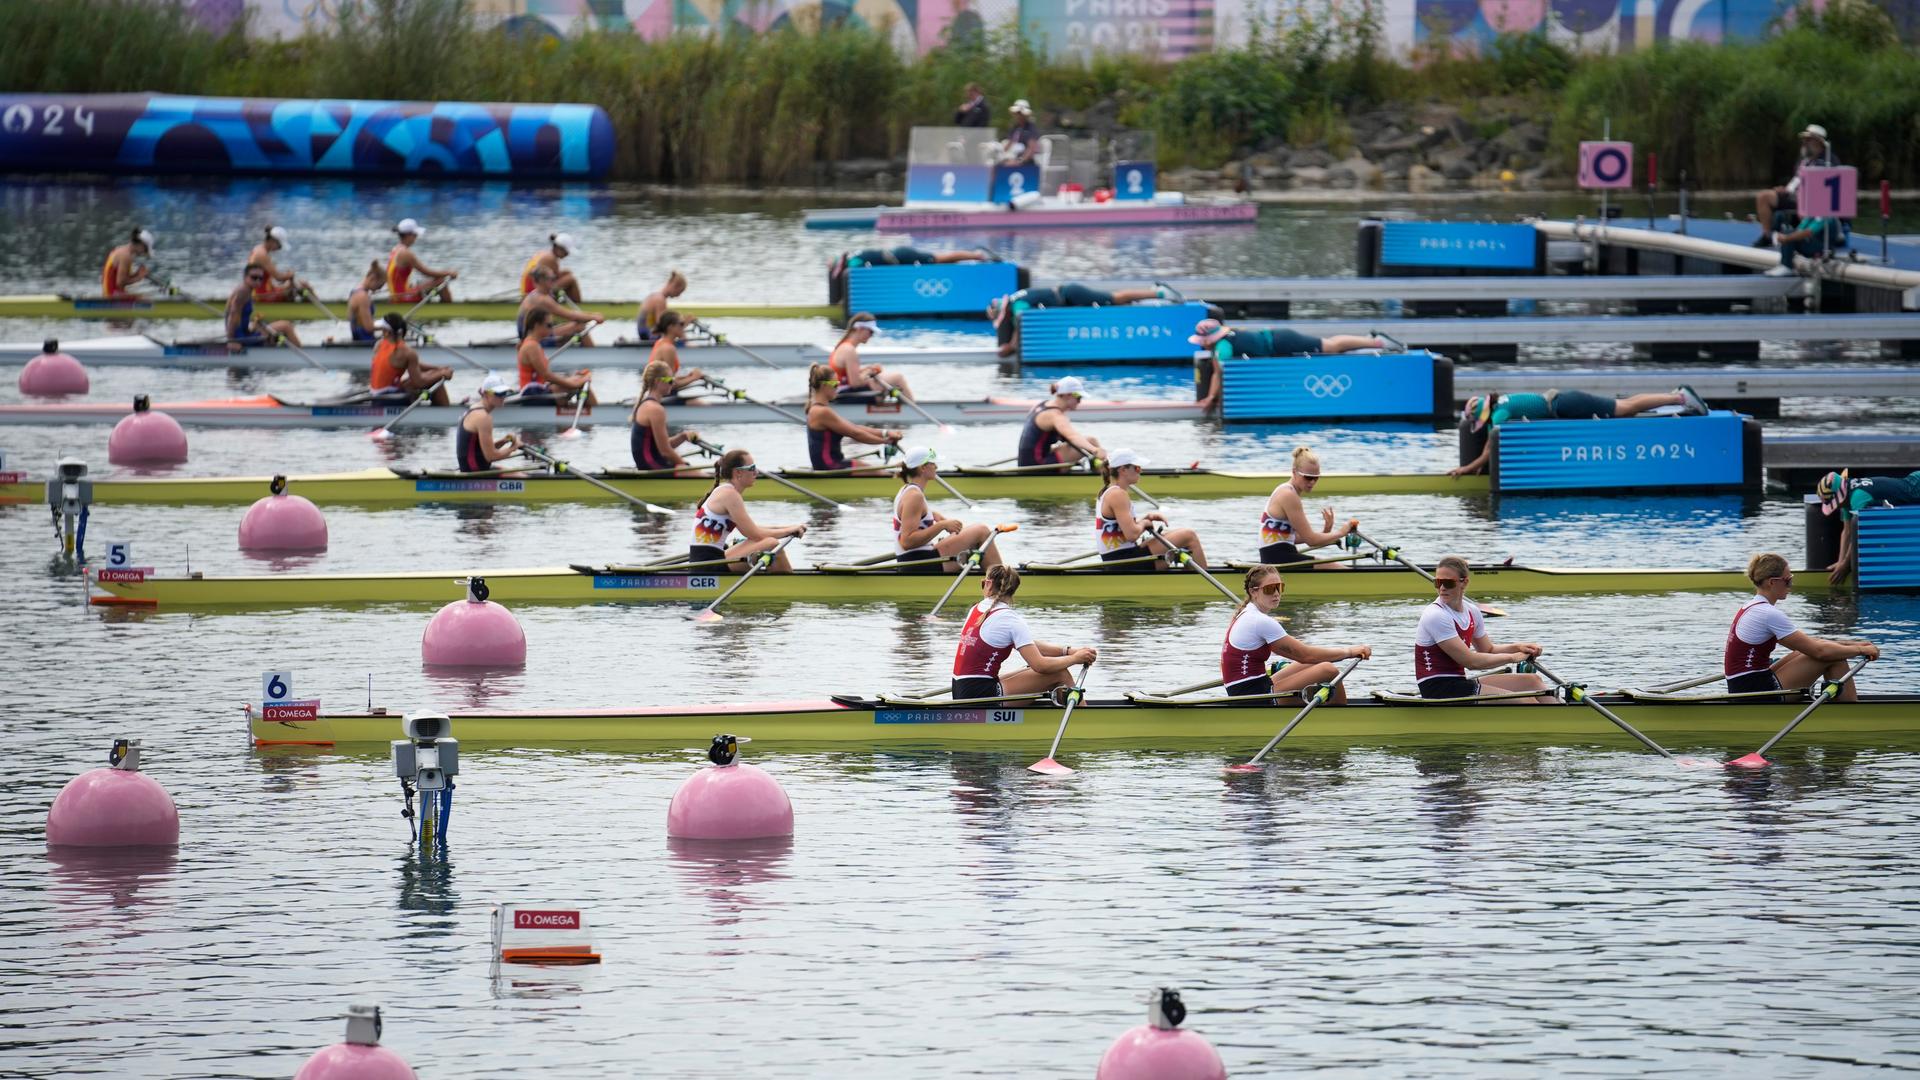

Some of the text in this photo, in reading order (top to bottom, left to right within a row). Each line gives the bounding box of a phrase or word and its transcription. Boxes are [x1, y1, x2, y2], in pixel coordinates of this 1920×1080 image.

[1064, 0, 1169, 17] PARIS
[1593, 149, 1627, 182] 0
[1824, 174, 1841, 211] 1
[1067, 325, 1172, 339] PARIS 2024
[1561, 444, 1695, 461] PARIS 2024
[499, 481, 523, 490] GBR
[110, 545, 126, 565] 5
[620, 578, 716, 587] PARIS 2024 GER
[267, 674, 288, 699] 6
[279, 710, 313, 718] OMEGA
[907, 711, 1016, 722] PARIS 2024 SUI
[533, 914, 575, 925] OMEGA
